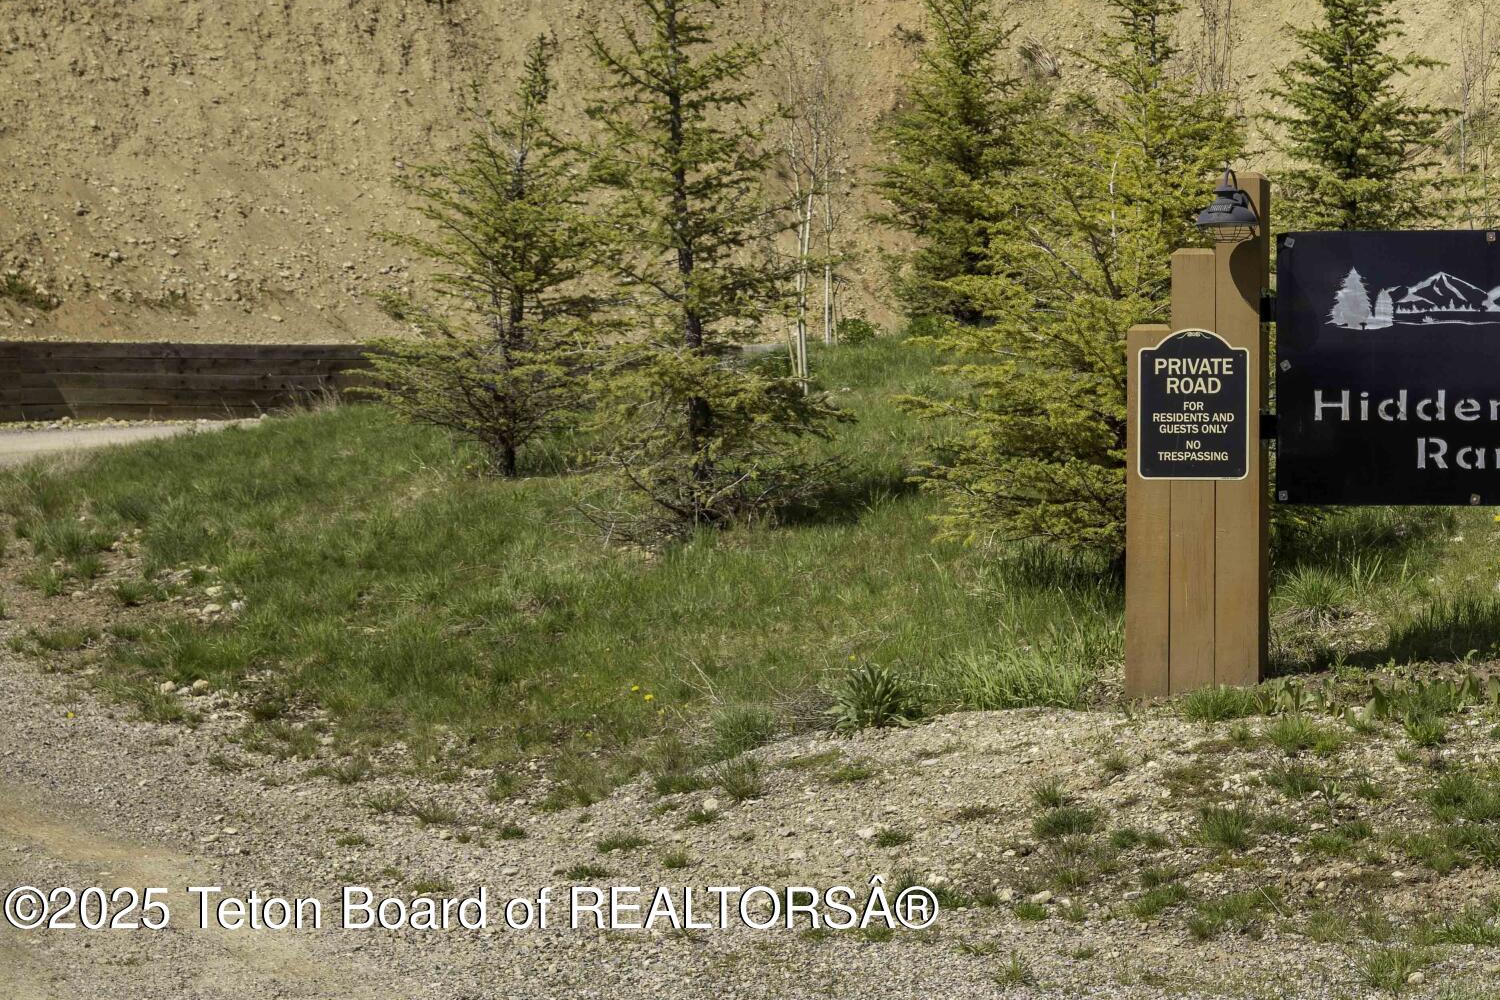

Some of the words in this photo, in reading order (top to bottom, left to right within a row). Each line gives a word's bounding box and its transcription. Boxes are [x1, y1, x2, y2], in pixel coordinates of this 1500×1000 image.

[1154, 357, 1234, 375] PRIVATE
[1166, 377, 1222, 395] ROAD
[1183, 401, 1205, 411] FOR
[1152, 412, 1210, 422] RESIDENTS
[1211, 412, 1235, 422] AND
[1159, 424, 1199, 434] GUESTS
[1201, 424, 1228, 434] ONLY
[1185, 440, 1202, 450] NO
[1157, 451, 1229, 461] TRESPASSING
